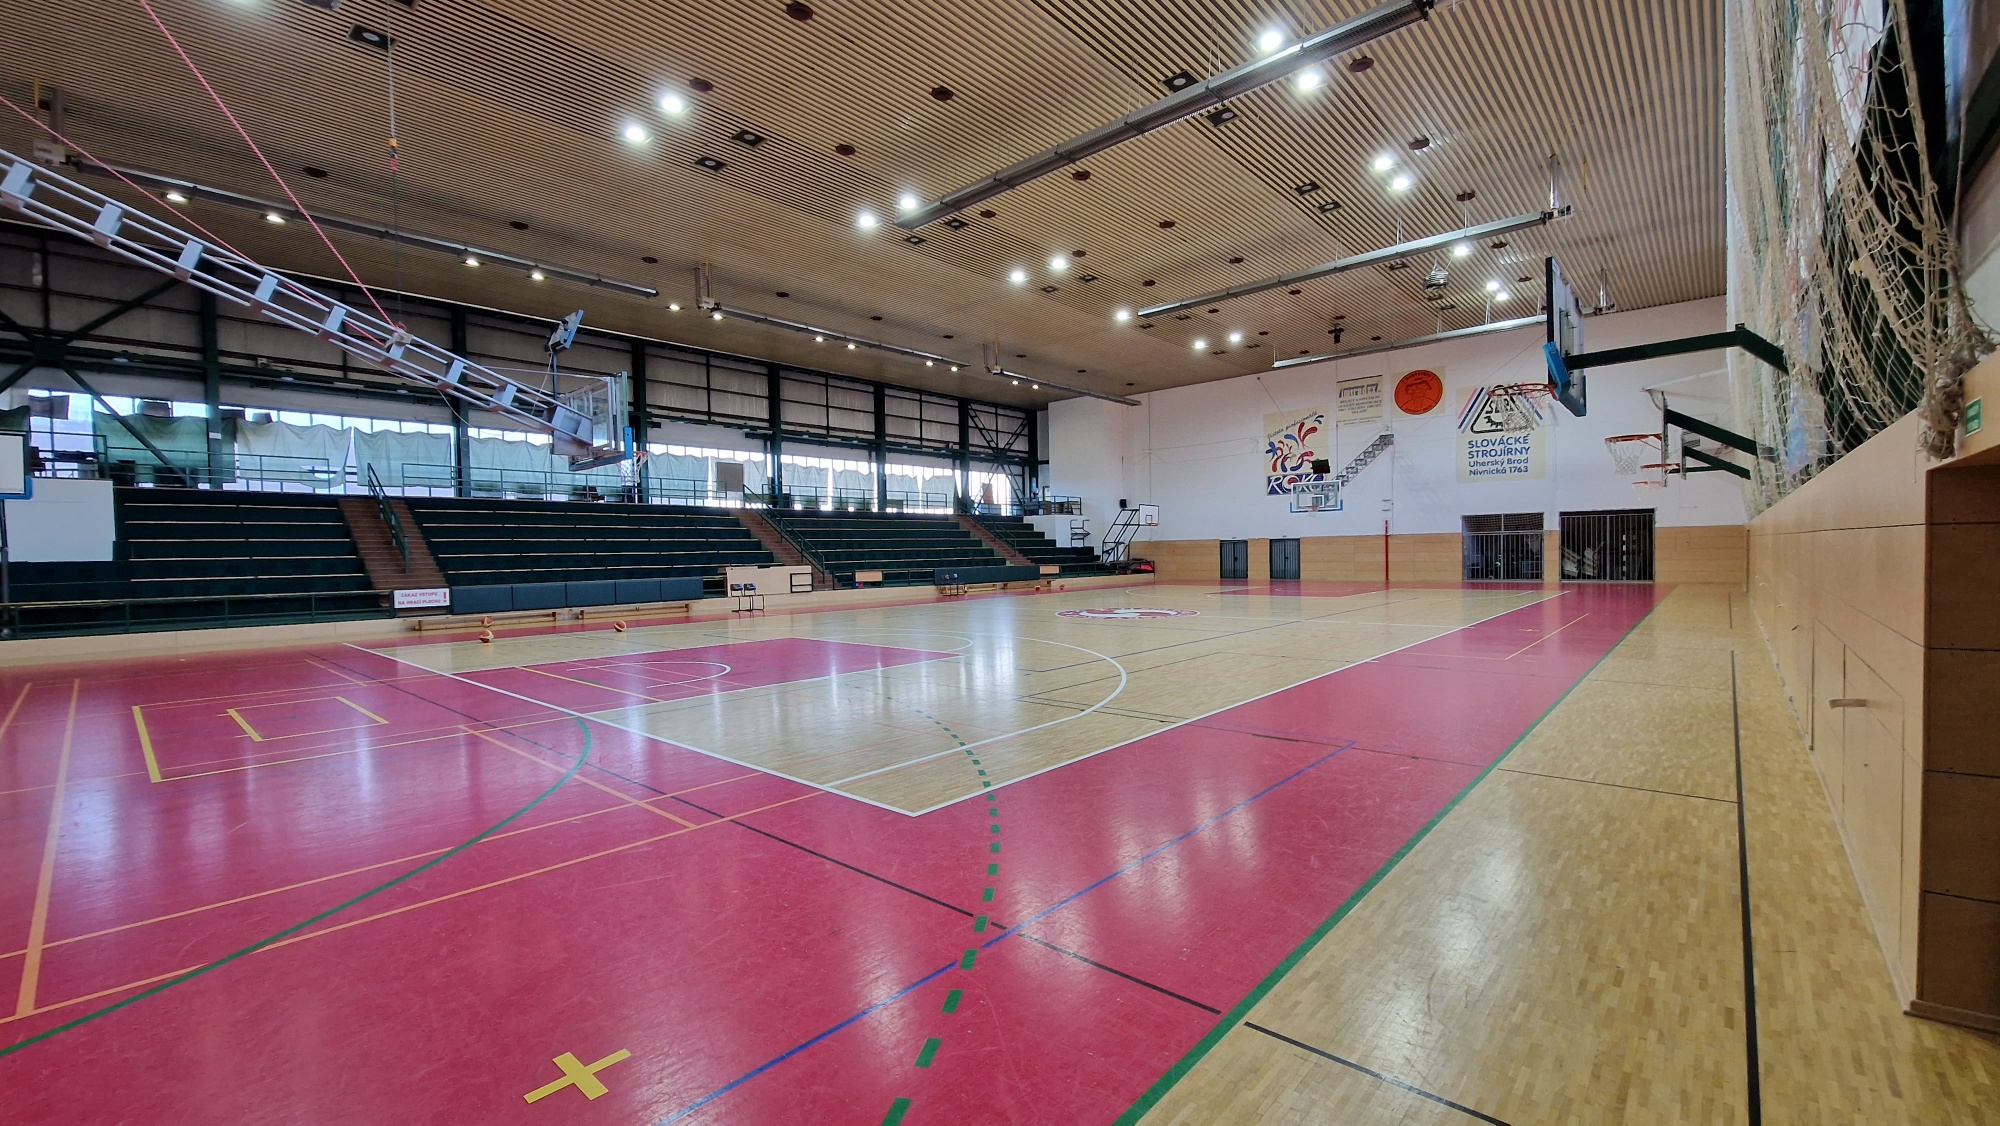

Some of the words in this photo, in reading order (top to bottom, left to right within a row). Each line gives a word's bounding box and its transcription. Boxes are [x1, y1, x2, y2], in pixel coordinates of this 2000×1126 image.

[1468, 433, 1530, 449] SLOVÁCKÉ
[1468, 446, 1530, 459] STROJÍRNY
[1469, 458, 1504, 467] Uherský
[1507, 457, 1529, 465] Brod
[1469, 466, 1506, 476] Nivnická
[1509, 465, 1529, 473] 1763
